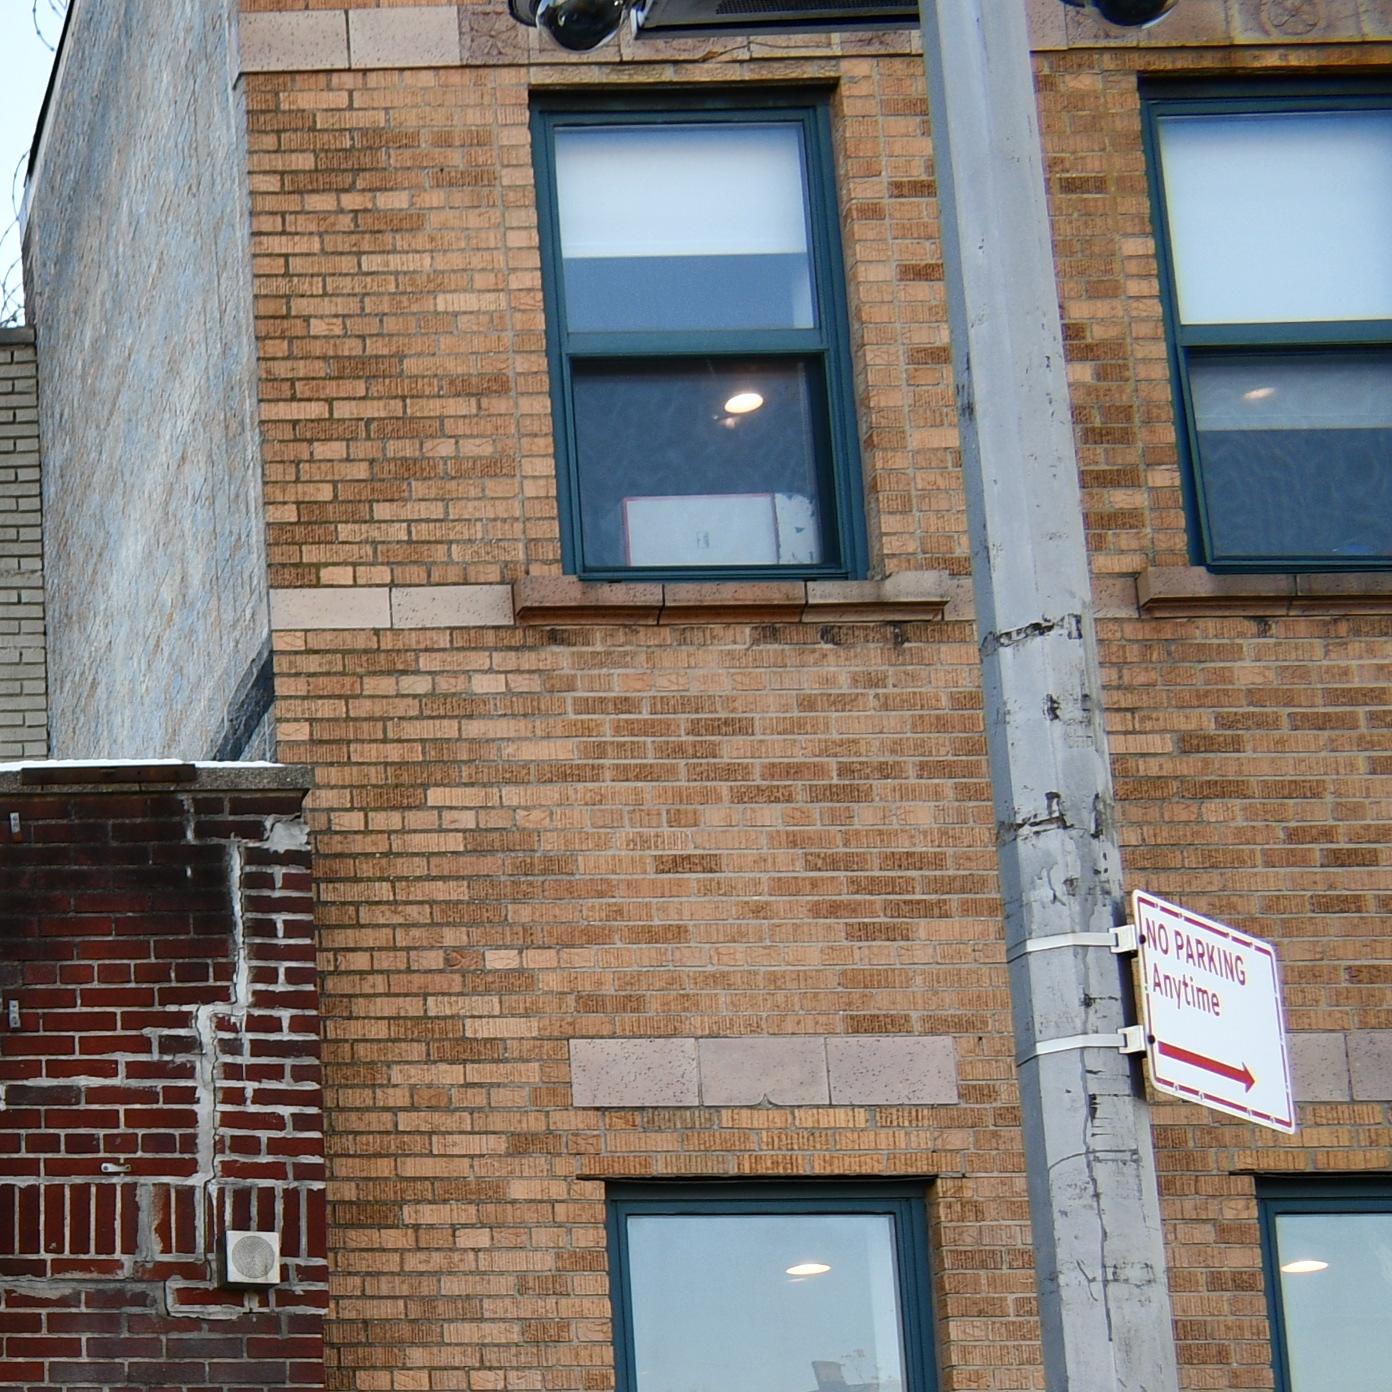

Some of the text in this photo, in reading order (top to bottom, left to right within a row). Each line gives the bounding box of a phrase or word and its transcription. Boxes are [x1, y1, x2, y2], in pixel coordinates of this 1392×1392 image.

[1145, 918, 1246, 986] NO PARKING
[1153, 963, 1221, 1017] Anytime
